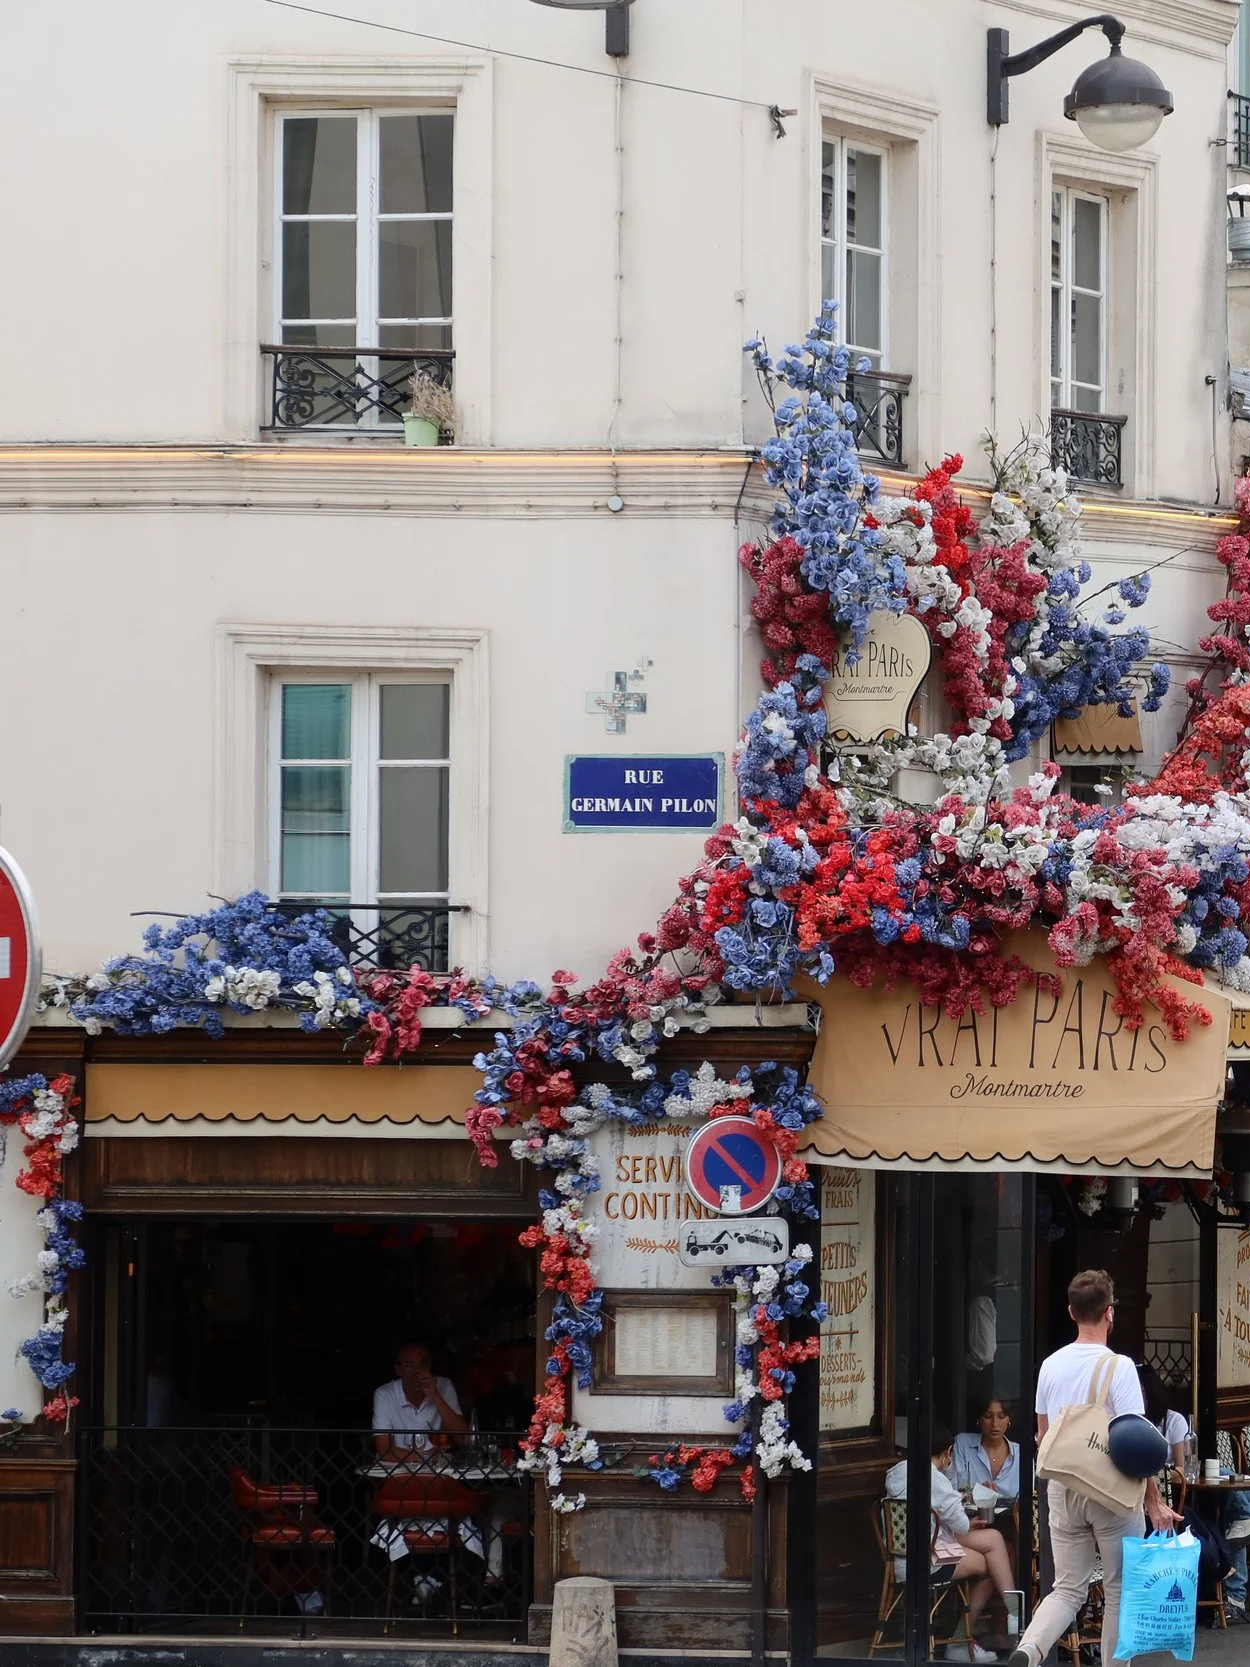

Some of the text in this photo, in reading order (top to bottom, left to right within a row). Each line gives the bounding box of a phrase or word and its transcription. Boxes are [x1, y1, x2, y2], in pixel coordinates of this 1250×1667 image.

[836, 683, 893, 696] Montmartre
[624, 769, 664, 784] RUE
[571, 798, 716, 813] GERMAIN PILON
[880, 999, 999, 1068] VRAI
[949, 1072, 1086, 1099] Montmartre
[616, 1155, 687, 1184] SERVI
[824, 1190, 854, 1209] FRAIS
[820, 1241, 857, 1271] PETITS
[820, 1270, 868, 1317] JEUNERS
[819, 1367, 867, 1386] ourmands
